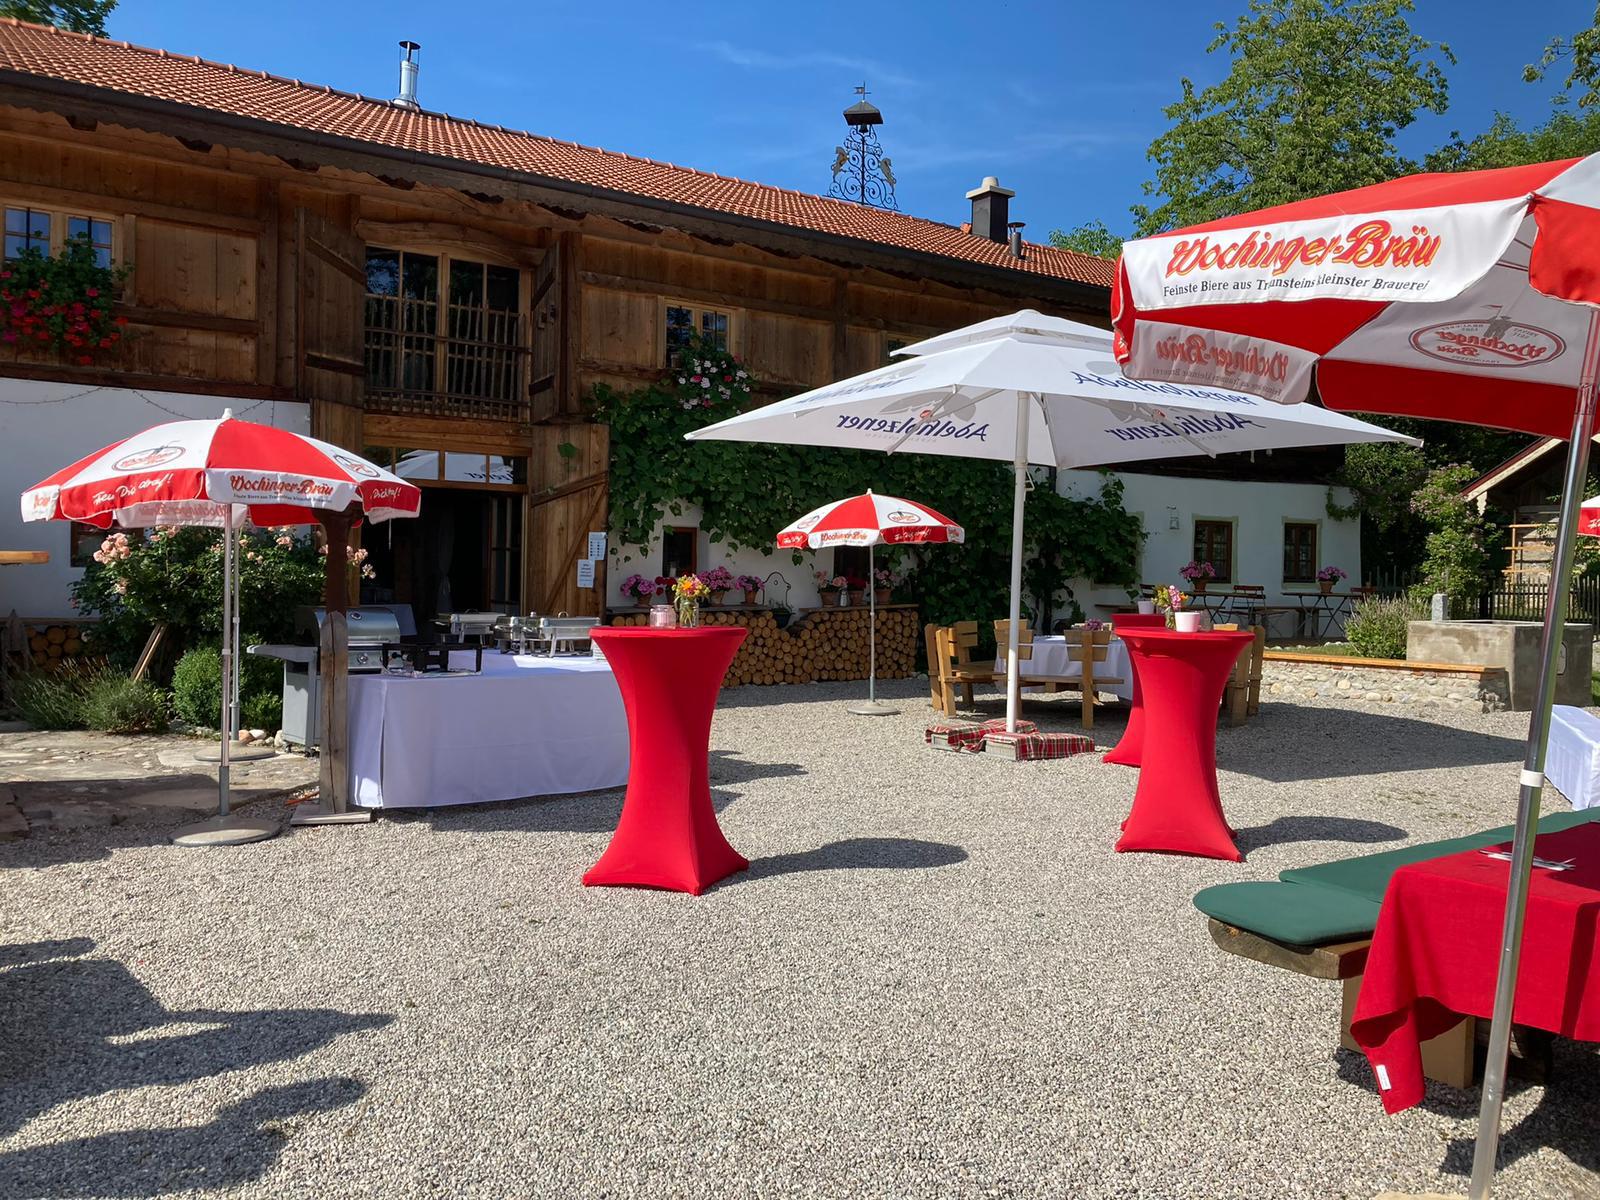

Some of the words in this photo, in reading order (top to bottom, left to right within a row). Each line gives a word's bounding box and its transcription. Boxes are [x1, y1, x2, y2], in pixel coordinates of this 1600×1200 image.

[1165, 219, 1441, 279] Wochinger-Bräu
[1163, 283, 1198, 297] Feinste
[1201, 280, 1229, 292] Biere
[1233, 281, 1252, 290] aus
[1256, 277, 1315, 291] Trunsteins
[1372, 278, 1430, 291] Brauerei
[230, 475, 334, 495] Wochinger-Bräu
